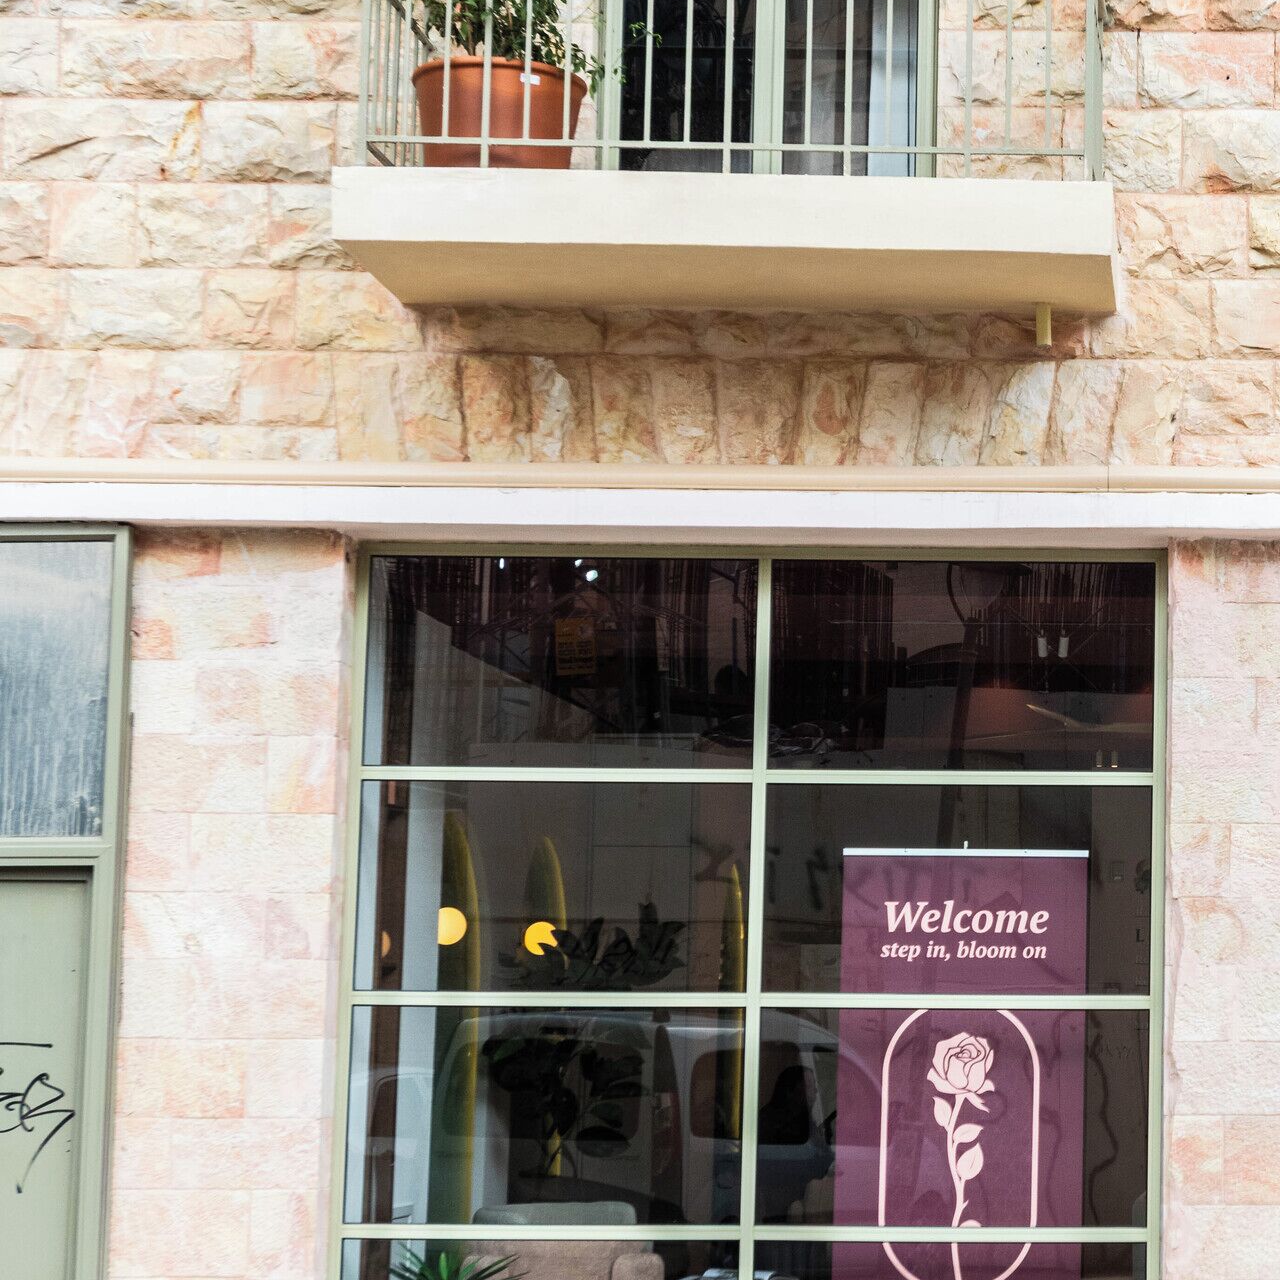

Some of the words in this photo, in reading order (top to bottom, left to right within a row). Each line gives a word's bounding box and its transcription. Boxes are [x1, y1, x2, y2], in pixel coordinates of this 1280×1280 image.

[884, 899, 1050, 934] Welcome
[879, 942, 922, 962] step
[926, 940, 951, 962] in,
[956, 940, 1017, 959] bloom
[1022, 945, 1047, 959] on
